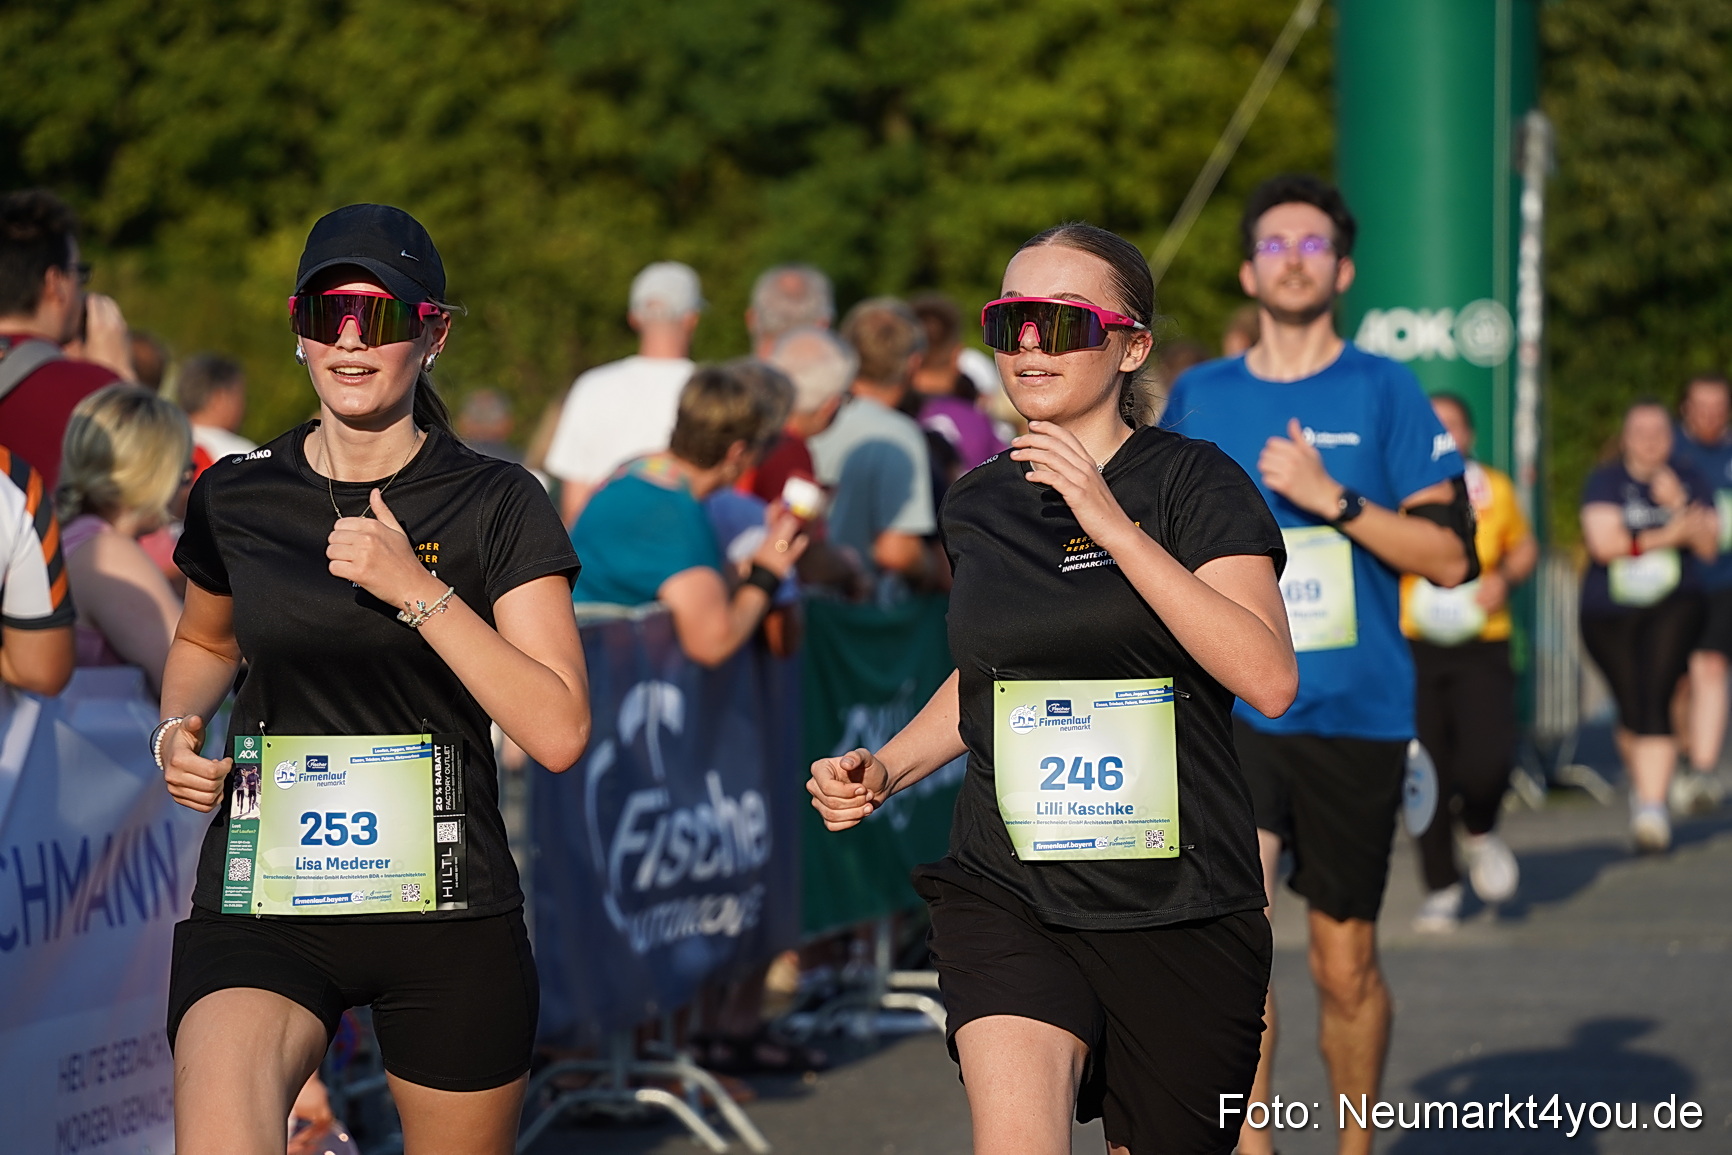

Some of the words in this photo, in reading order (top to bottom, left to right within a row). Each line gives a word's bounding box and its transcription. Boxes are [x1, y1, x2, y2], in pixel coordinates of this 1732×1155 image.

[1354, 307, 1457, 362] AOK
[245, 449, 272, 460] JAKO
[1064, 550, 1110, 564] ARCHITEKT
[1038, 715, 1091, 727] Firmenlauf
[1060, 724, 1091, 732] neumarkt
[238, 750, 258, 759] AOK
[434, 744, 442, 786] RABATT
[298, 770, 347, 782] Firmenlauf
[1039, 756, 1124, 791] 246
[435, 787, 442, 795] %
[444, 776, 452, 810] FACTORY
[435, 796, 443, 811] 20
[1036, 802, 1063, 815] Lilli
[1067, 802, 1134, 816] Kaschke
[300, 812, 378, 846] 253
[1036, 840, 1092, 850] firmenlauf.bayern
[296, 856, 322, 870] Lisa
[326, 856, 391, 870] Mederer
[441, 848, 453, 898] HILTL
[294, 896, 349, 905] firmenlauf.bayern
